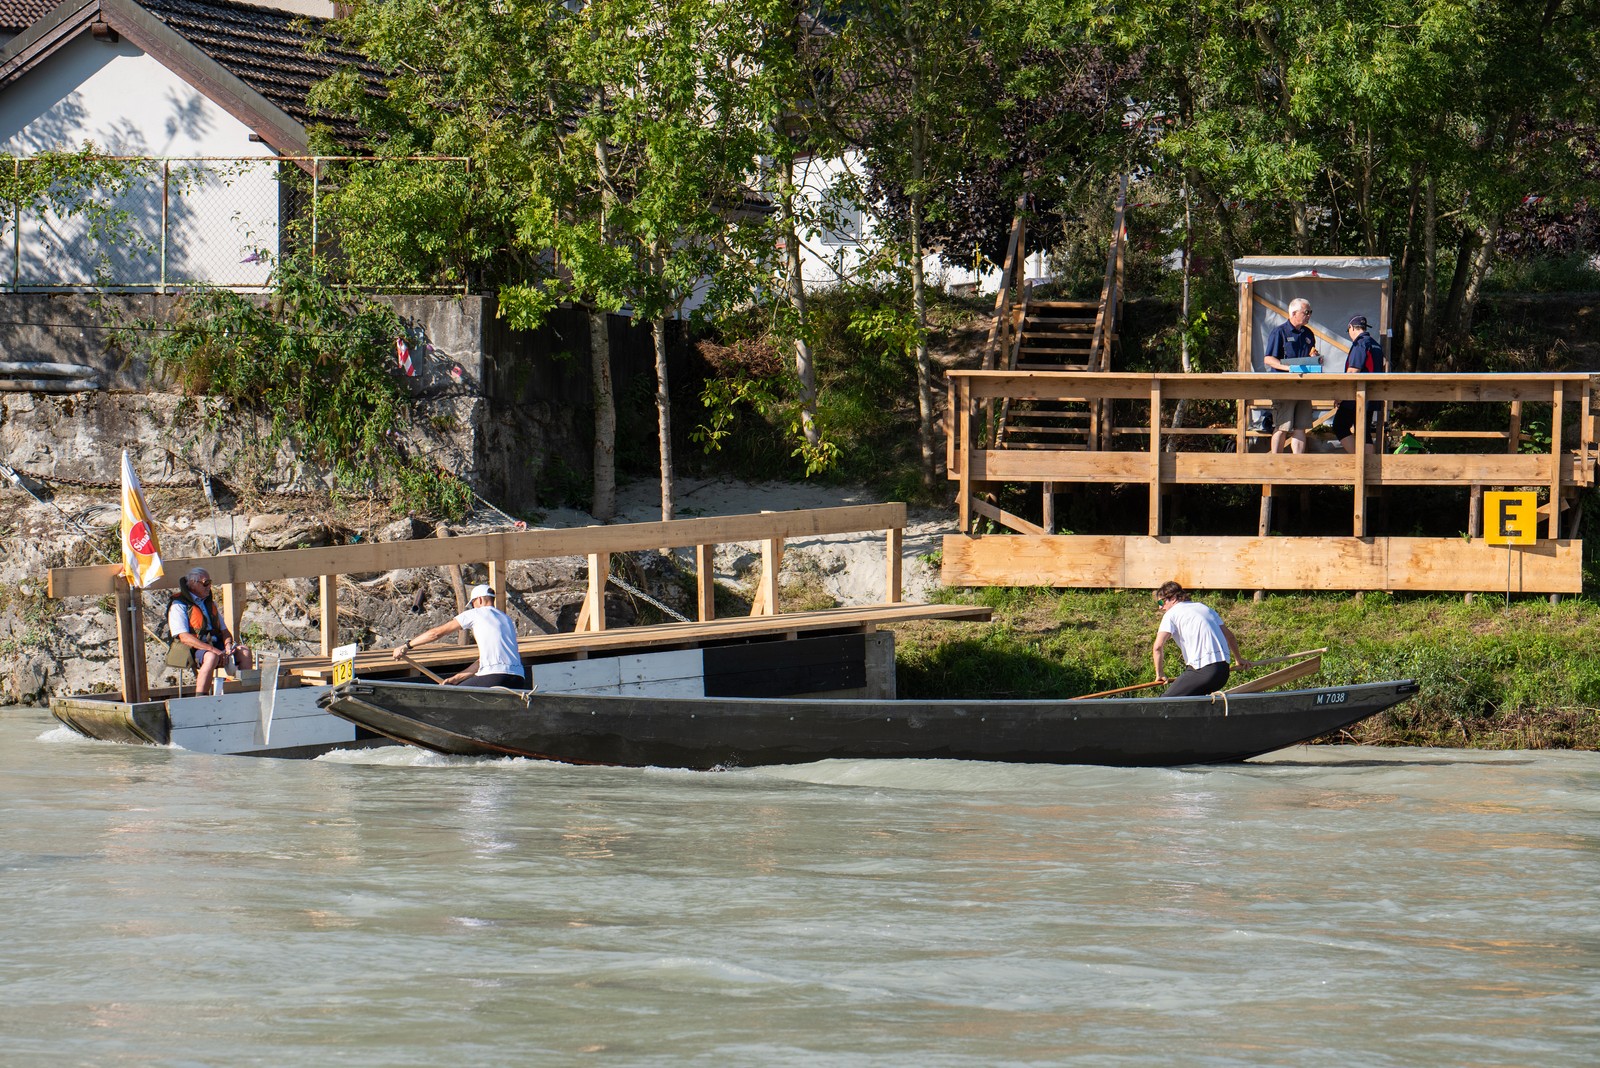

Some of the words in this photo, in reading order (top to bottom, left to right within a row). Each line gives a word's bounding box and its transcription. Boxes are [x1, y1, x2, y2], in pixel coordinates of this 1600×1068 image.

[1499, 499, 1522, 537] E
[335, 661, 353, 682] 123
[1316, 694, 1324, 704] M
[1325, 692, 1346, 704] 7038
